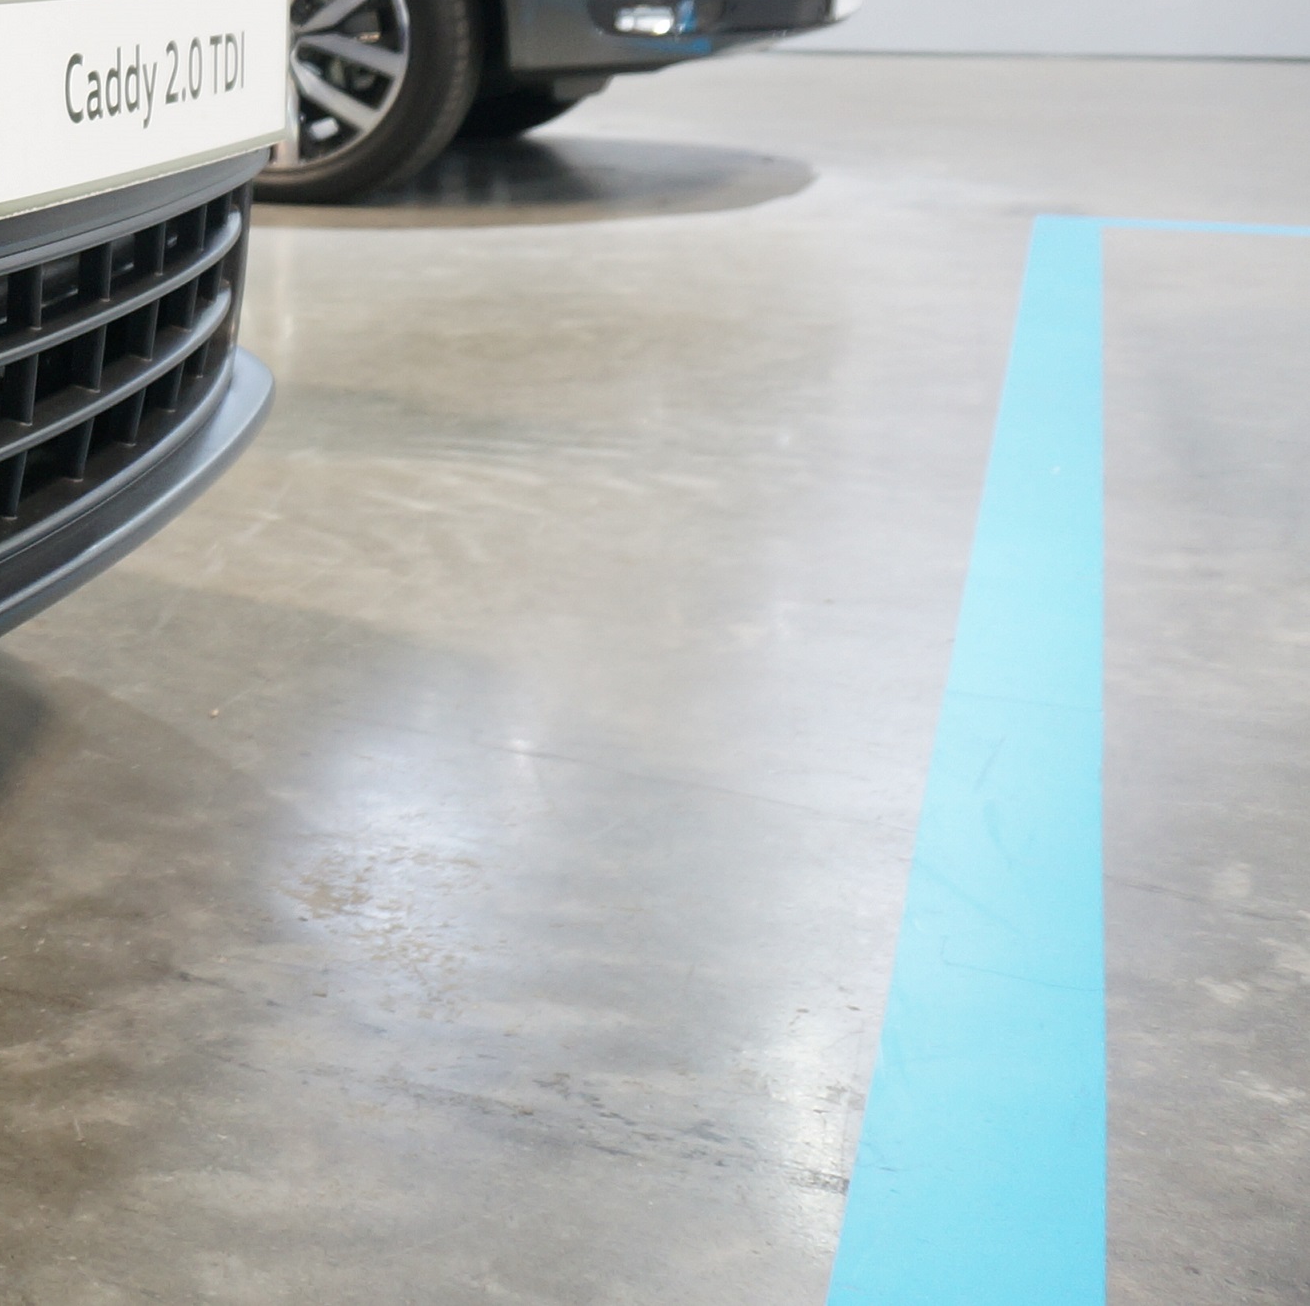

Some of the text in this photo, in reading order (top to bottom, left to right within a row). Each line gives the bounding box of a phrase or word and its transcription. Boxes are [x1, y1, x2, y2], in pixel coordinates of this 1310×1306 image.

[64, 31, 246, 129] Caddy 2.0 TDI
